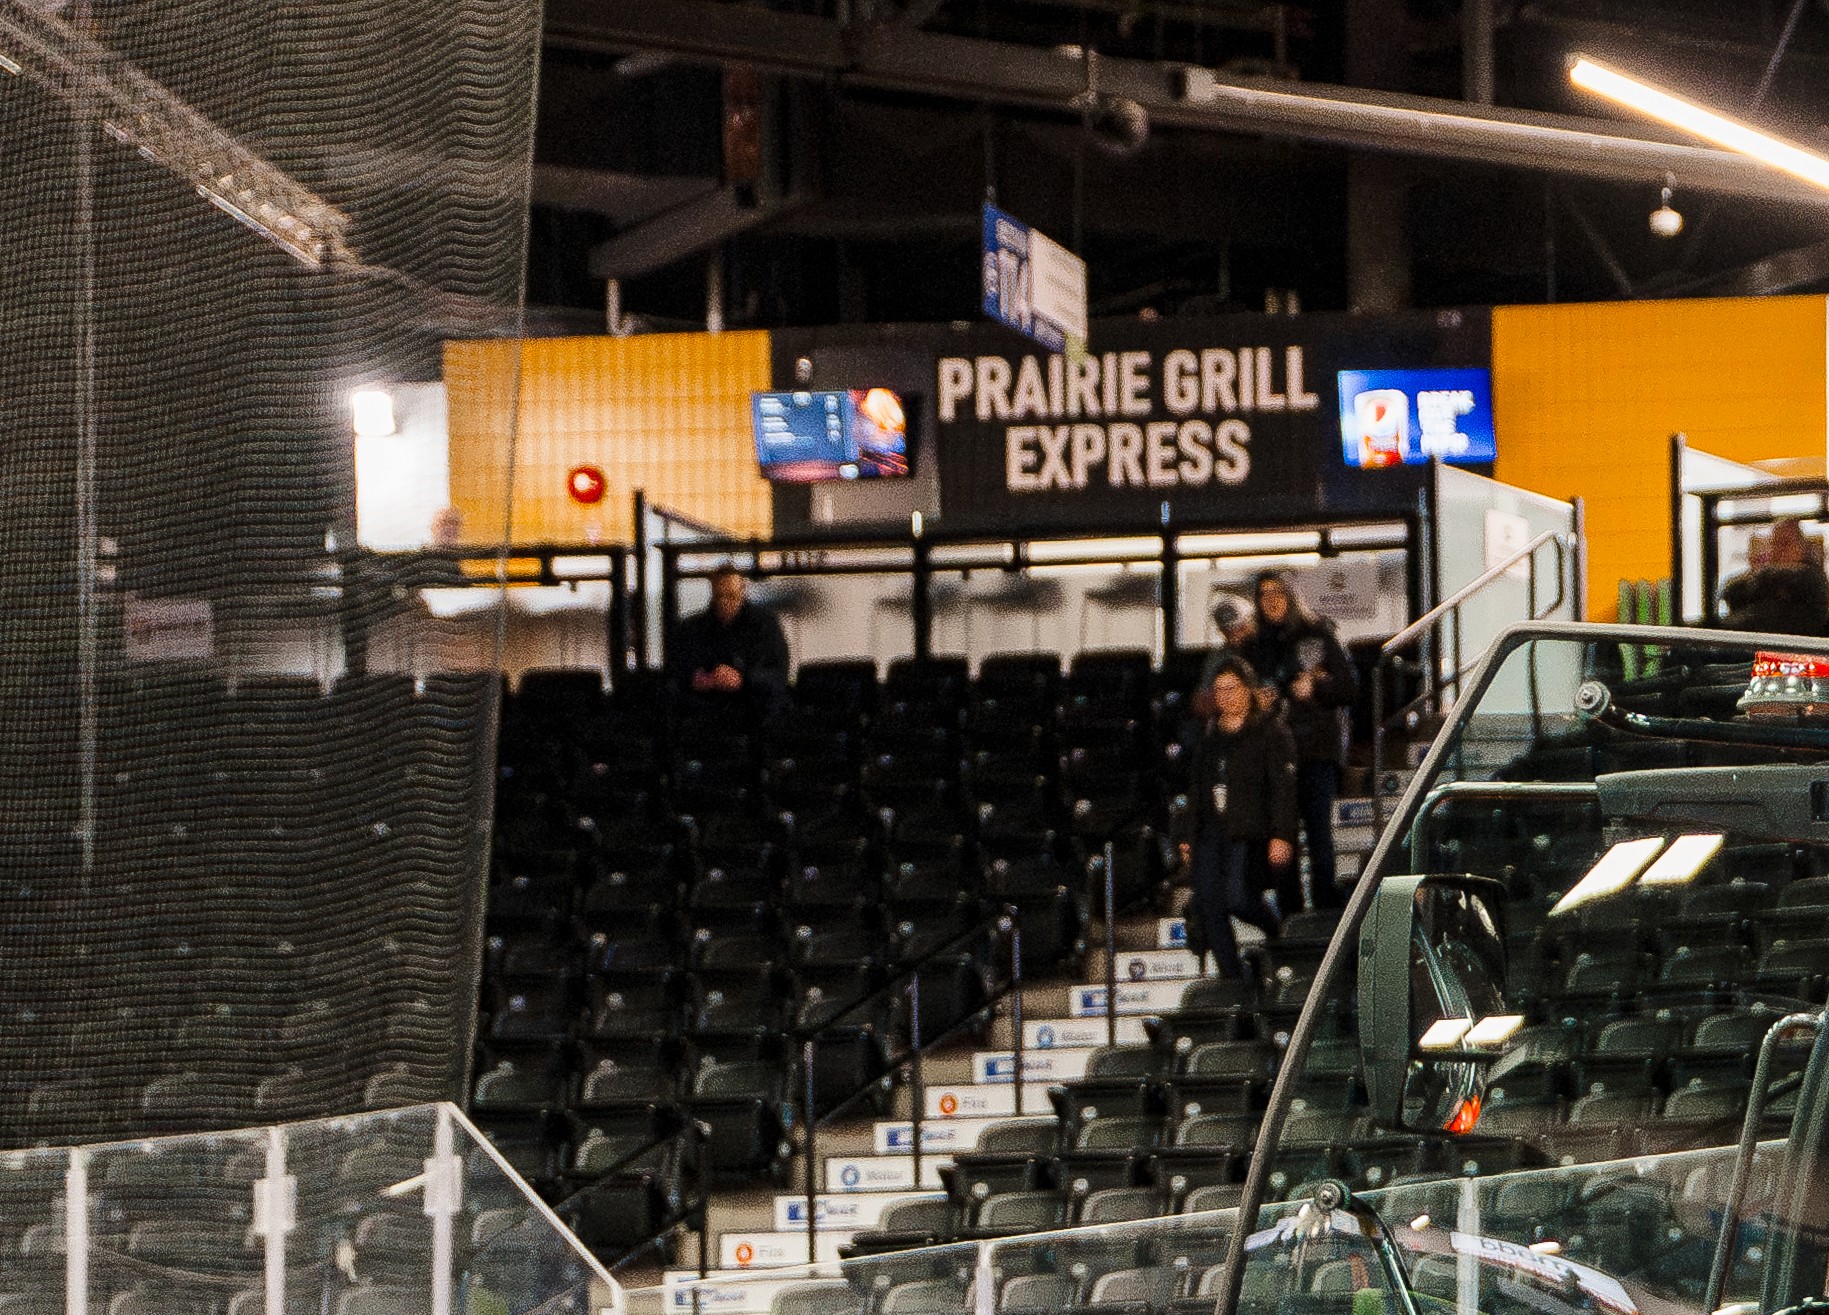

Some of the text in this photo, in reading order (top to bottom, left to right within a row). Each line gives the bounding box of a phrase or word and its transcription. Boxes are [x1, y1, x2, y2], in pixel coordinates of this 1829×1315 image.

[938, 344, 1319, 420] PRAIRIE GRILL
[1004, 420, 1250, 491] EXPRESS
